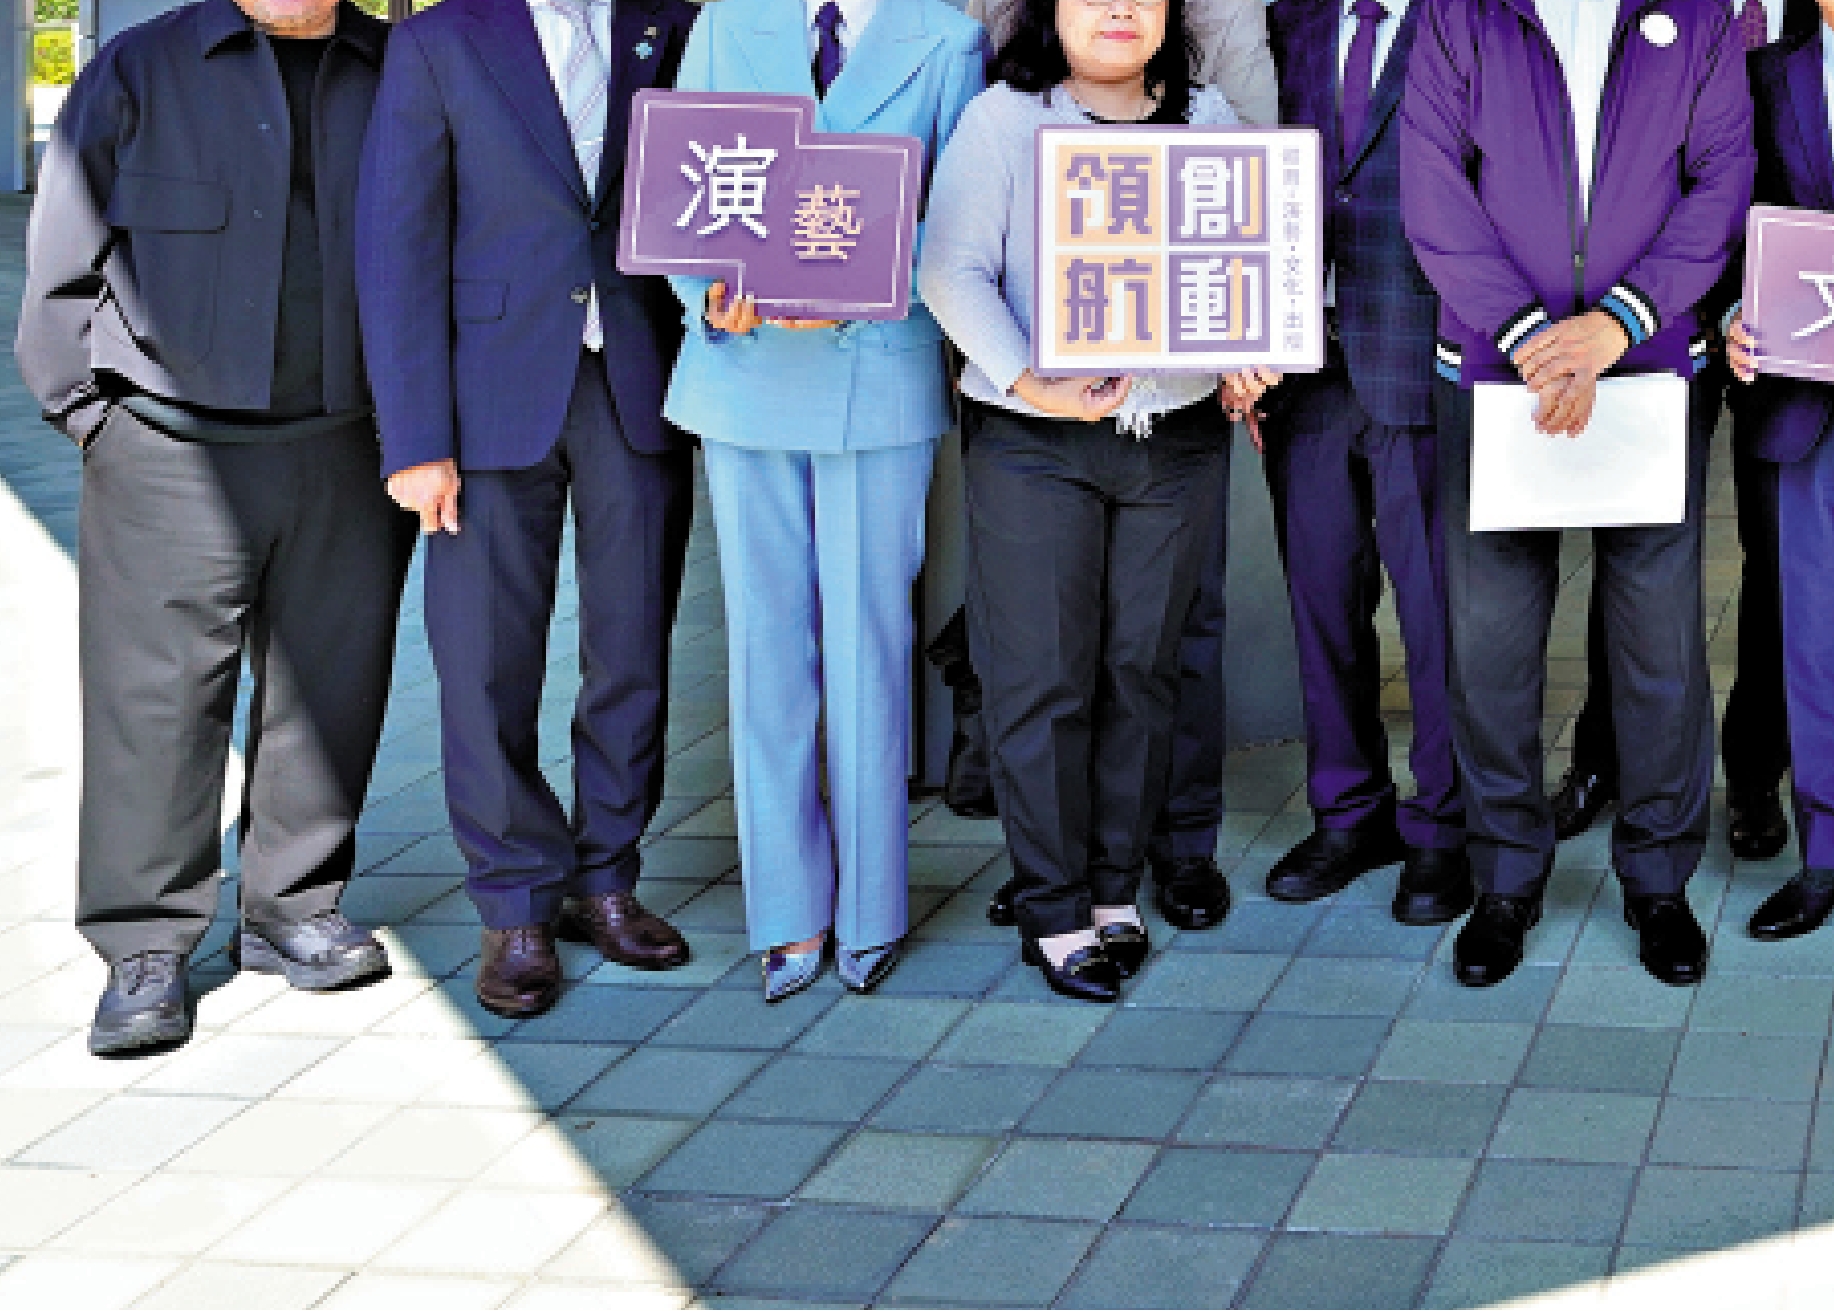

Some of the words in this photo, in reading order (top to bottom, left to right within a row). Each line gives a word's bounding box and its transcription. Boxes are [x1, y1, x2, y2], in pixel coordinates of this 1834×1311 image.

[676, 133, 863, 261] 演藝
[1063, 151, 1153, 344] 領航
[1177, 152, 1263, 343] 創動
